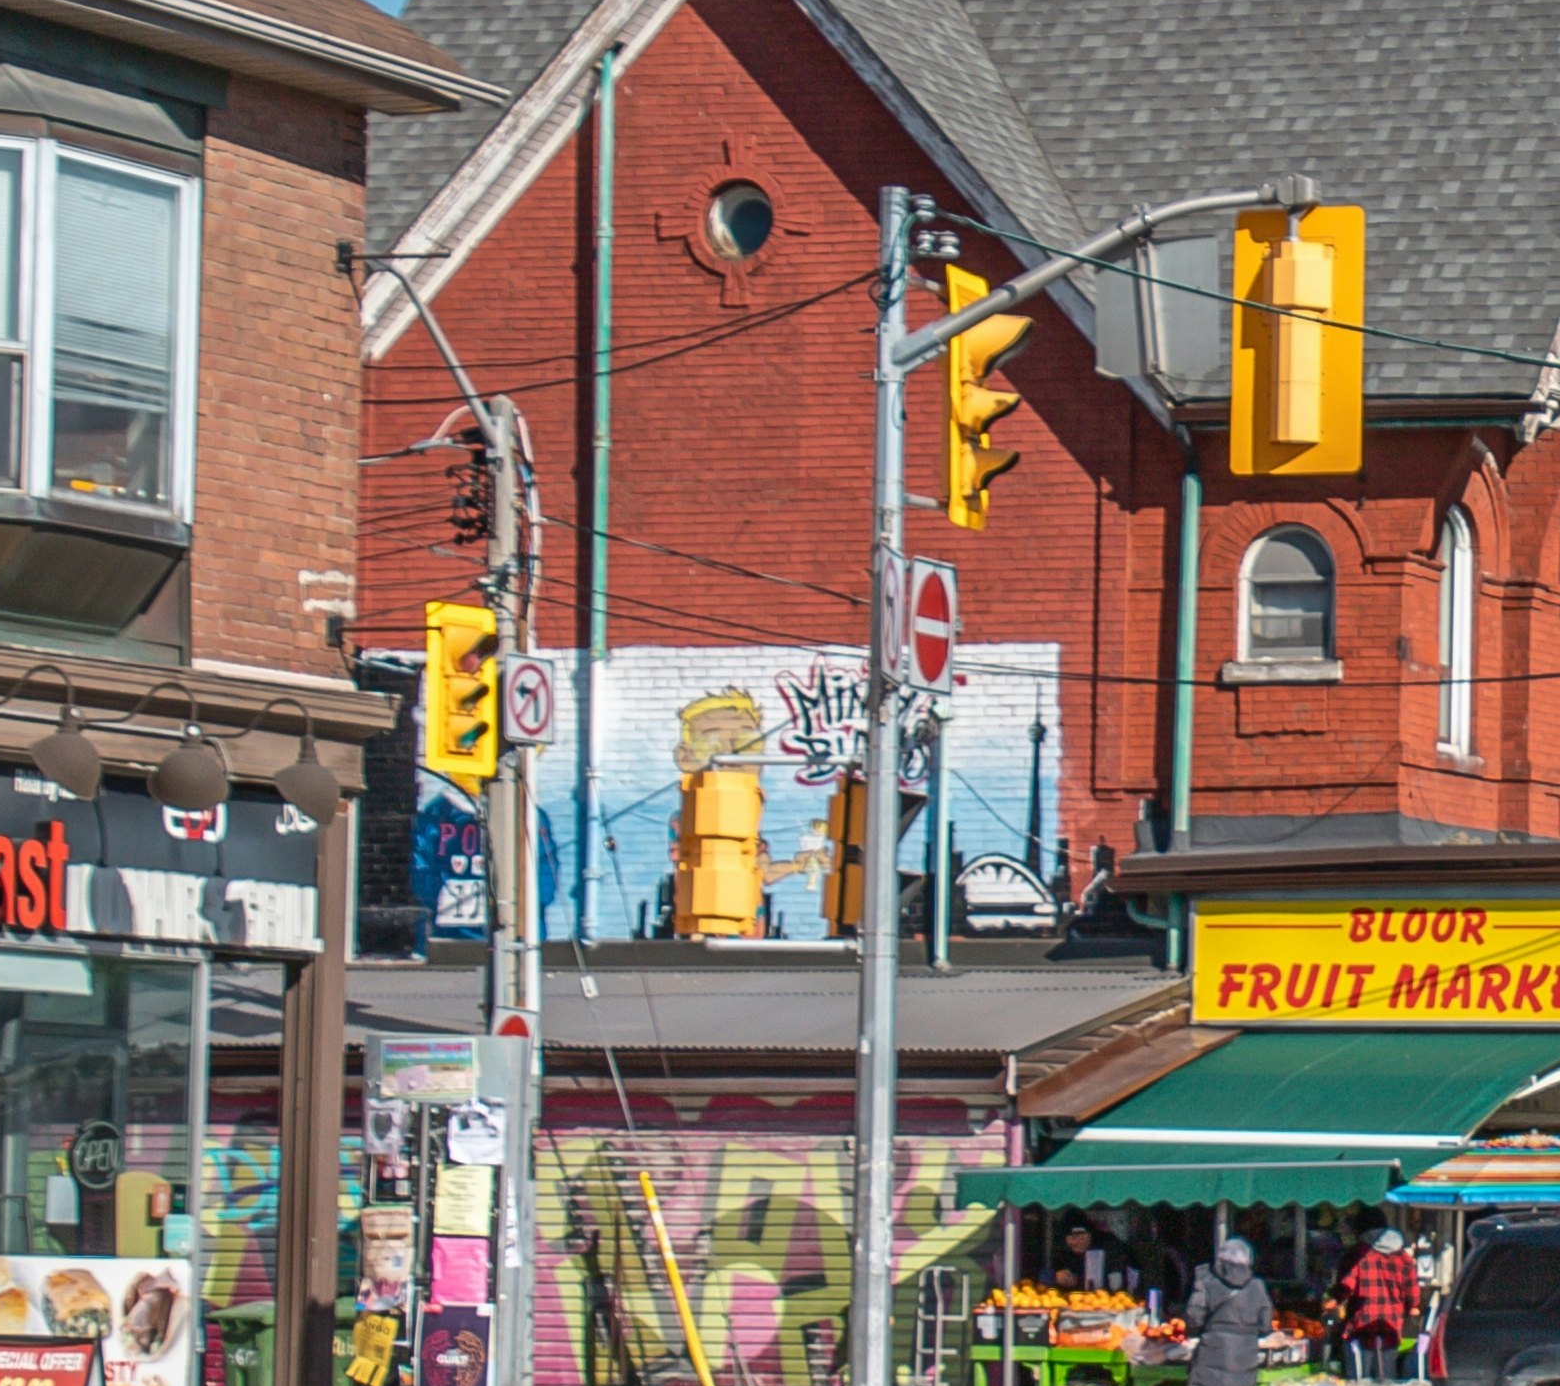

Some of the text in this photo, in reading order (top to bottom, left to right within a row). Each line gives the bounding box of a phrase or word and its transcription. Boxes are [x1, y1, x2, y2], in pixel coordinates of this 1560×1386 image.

[1349, 906, 1488, 946] BLOOR
[1217, 962, 1367, 1013] FRUIT
[39, 1351, 87, 1373] OFFER
[104, 1360, 138, 1382] STY
